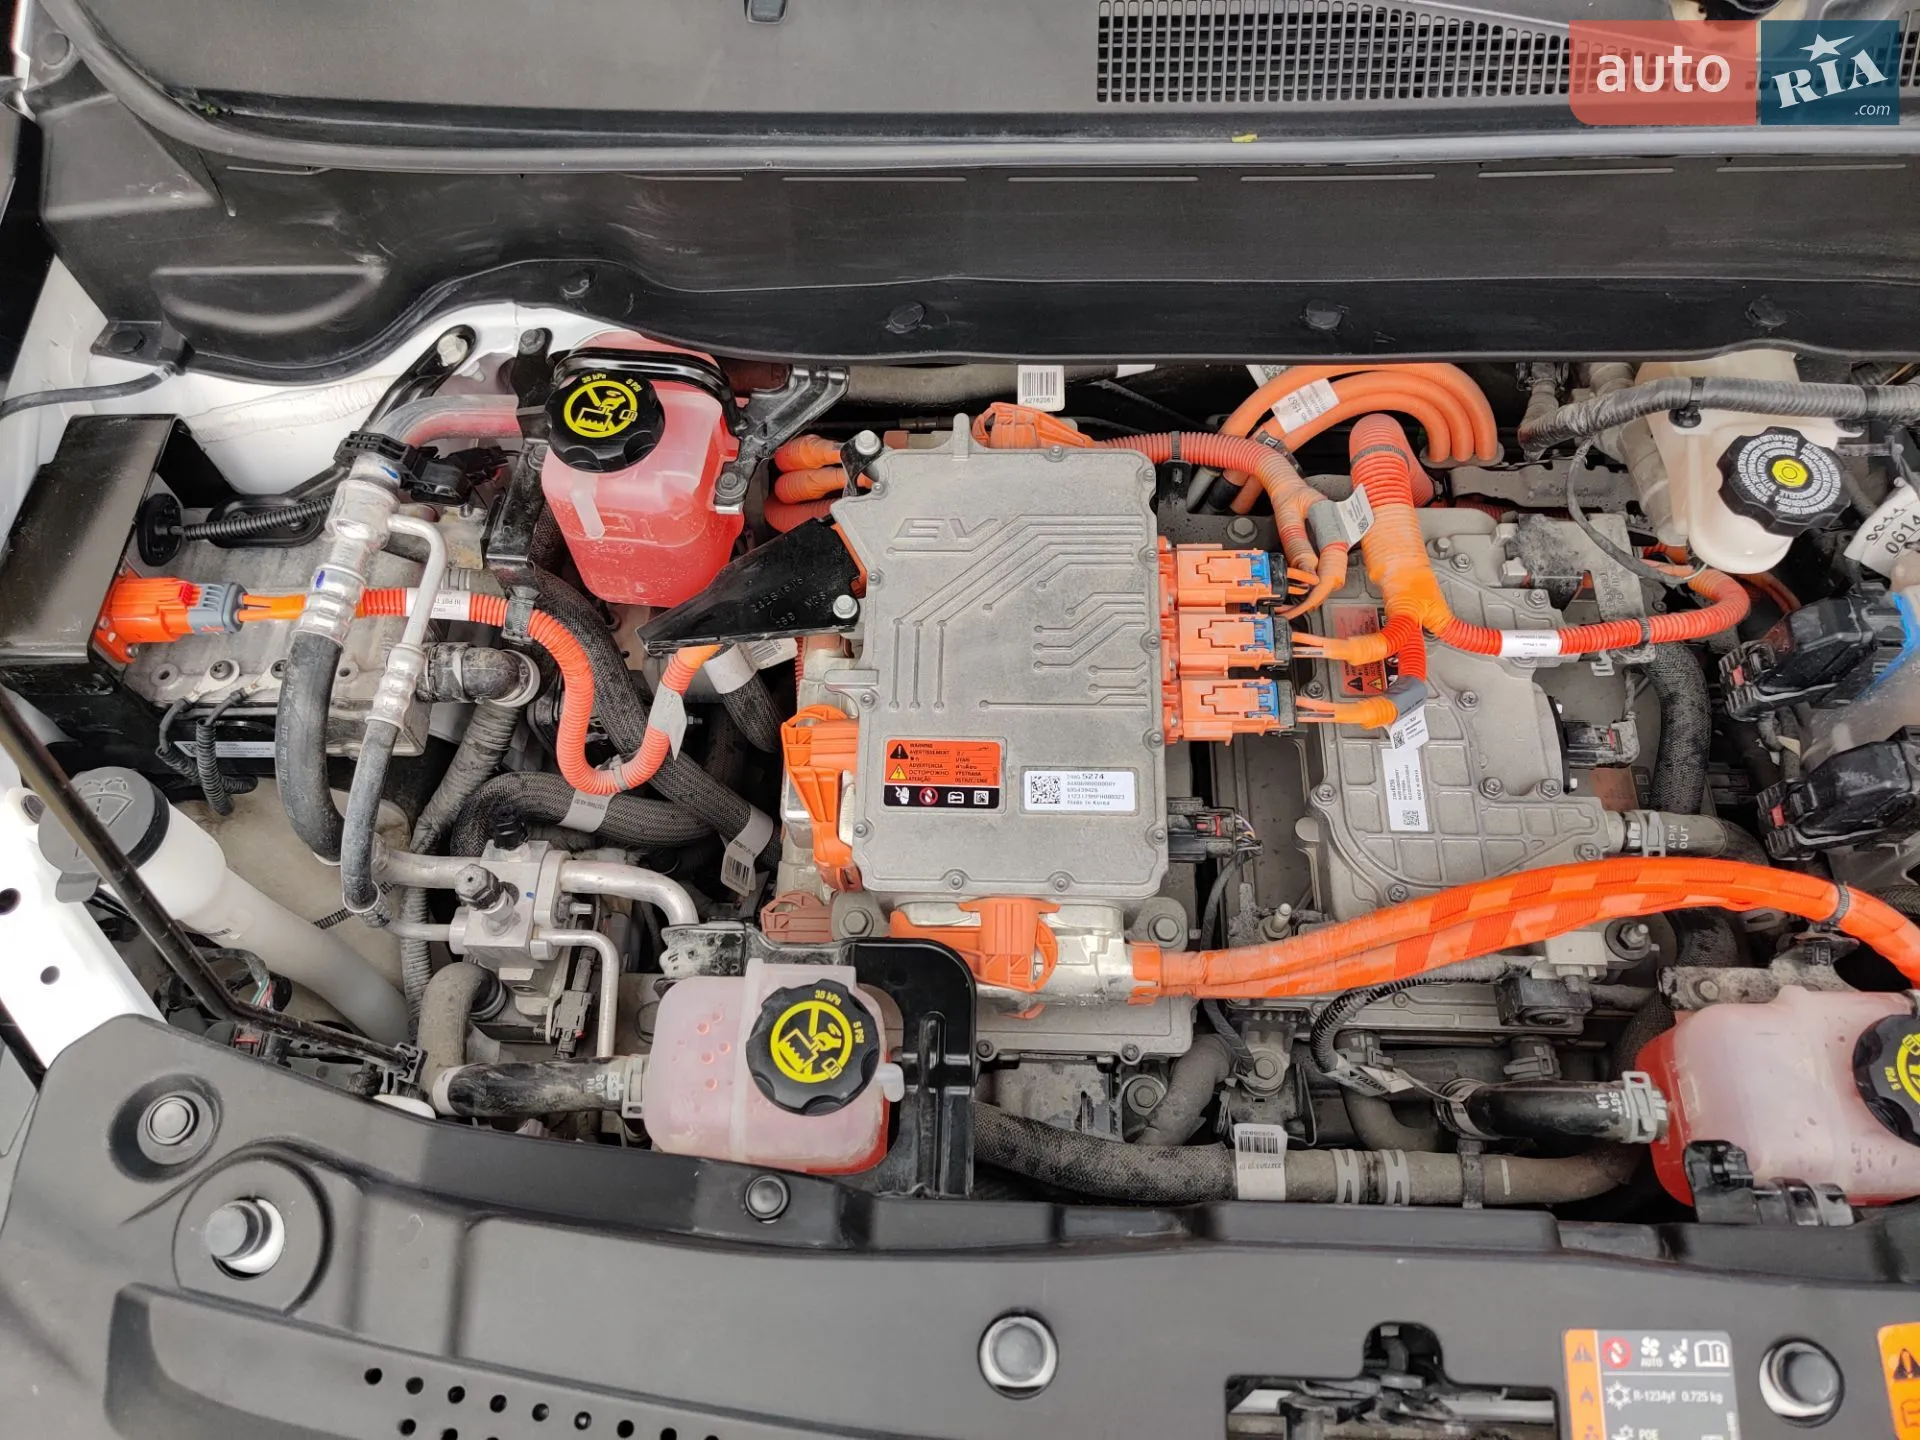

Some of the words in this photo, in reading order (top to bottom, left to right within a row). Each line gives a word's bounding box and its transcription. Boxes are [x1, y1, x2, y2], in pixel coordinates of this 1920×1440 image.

[894, 518, 998, 541] EV
[1679, 825, 1689, 849] OUT
[815, 990, 825, 999] 35
[826, 992, 841, 1006] kPa
[854, 1028, 864, 1043] PSI
[596, 1074, 605, 1098] SGT
[1595, 1094, 1609, 1109] LH
[1609, 1092, 1623, 1115] SGT
[1710, 1391, 1723, 1405] kg
